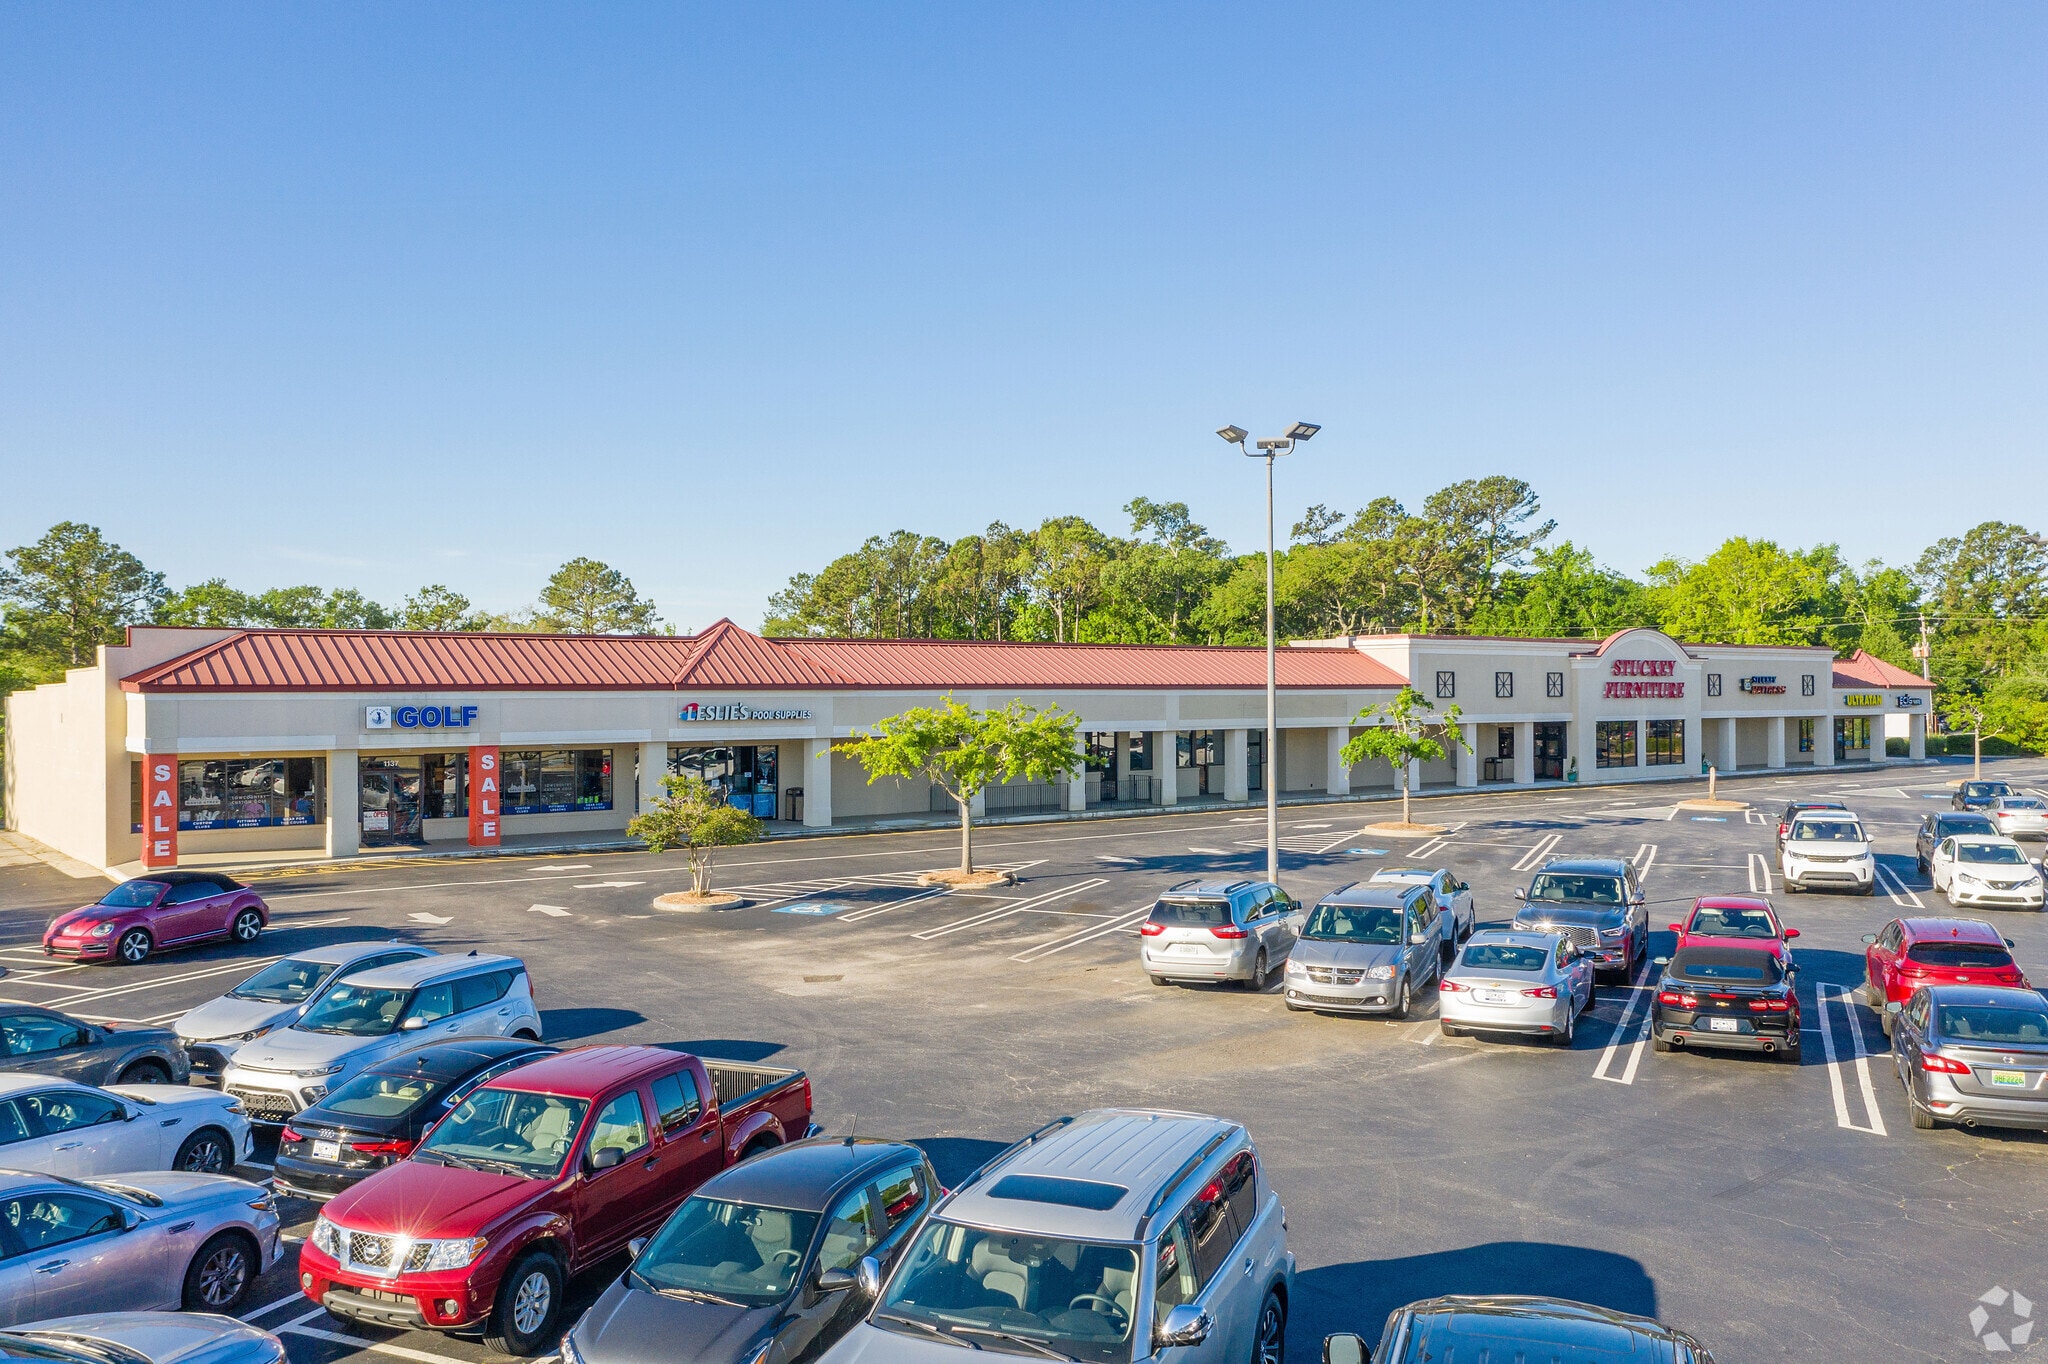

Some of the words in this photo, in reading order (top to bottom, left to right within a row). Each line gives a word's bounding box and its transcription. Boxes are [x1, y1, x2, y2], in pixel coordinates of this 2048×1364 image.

[1612, 660, 1676, 676] STUCKEY
[1604, 682, 1685, 698] FURNITURE
[396, 705, 478, 728] GOLF
[687, 703, 748, 720] LESLIE'S
[752, 711, 773, 720] POOL
[775, 710, 812, 720] SUPPLIES
[481, 754, 496, 837] SALE
[153, 765, 172, 856] SALE
